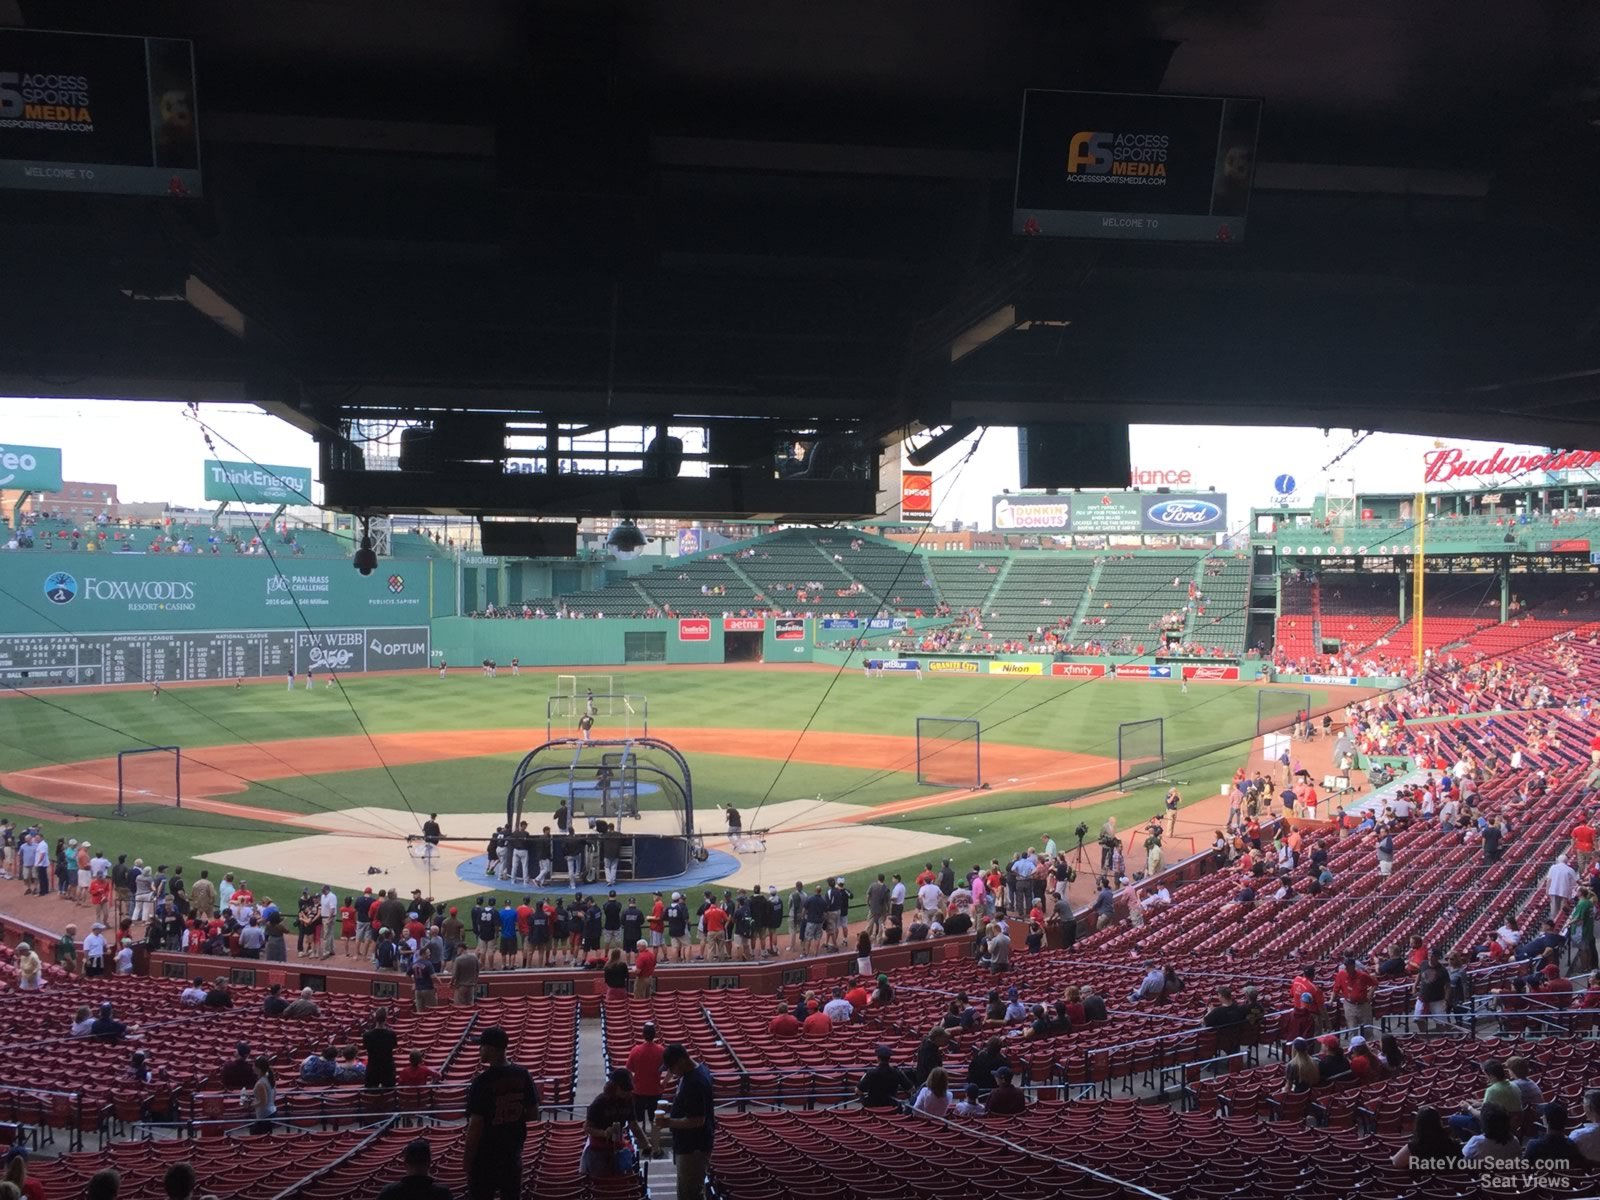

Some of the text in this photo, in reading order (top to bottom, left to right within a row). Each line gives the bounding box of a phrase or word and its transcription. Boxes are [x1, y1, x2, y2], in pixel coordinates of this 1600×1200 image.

[22, 74, 88, 90] ACCESS
[22, 89, 89, 106] SPORTS
[24, 106, 92, 122] MEDIA
[1115, 133, 1168, 148] ACCESS
[1114, 148, 1167, 162] SPORTS
[24, 168, 94, 179] WELCOME TO
[1112, 162, 1167, 177] MEDIA
[1066, 175, 1166, 186] ACCESSSPORTSMEDIA.COM
[1103, 218, 1158, 228] WELCOME TO
[1131, 466, 1191, 484] lance
[904, 488, 930, 496] ENEOS
[1016, 506, 1065, 515] DUNKIN'
[1162, 504, 1207, 521] Ford
[1016, 516, 1064, 525] DONUTS
[292, 576, 329, 584] PAN-MASS
[84, 578, 194, 600] FOXWOODS
[292, 584, 329, 592] CHALLENGE
[870, 620, 889, 628] NESN
[325, 633, 363, 646] WEBB
[384, 643, 425, 655] OPTUM
[930, 661, 977, 672] GRANITE CITY
[1064, 666, 1093, 676] xfinity
